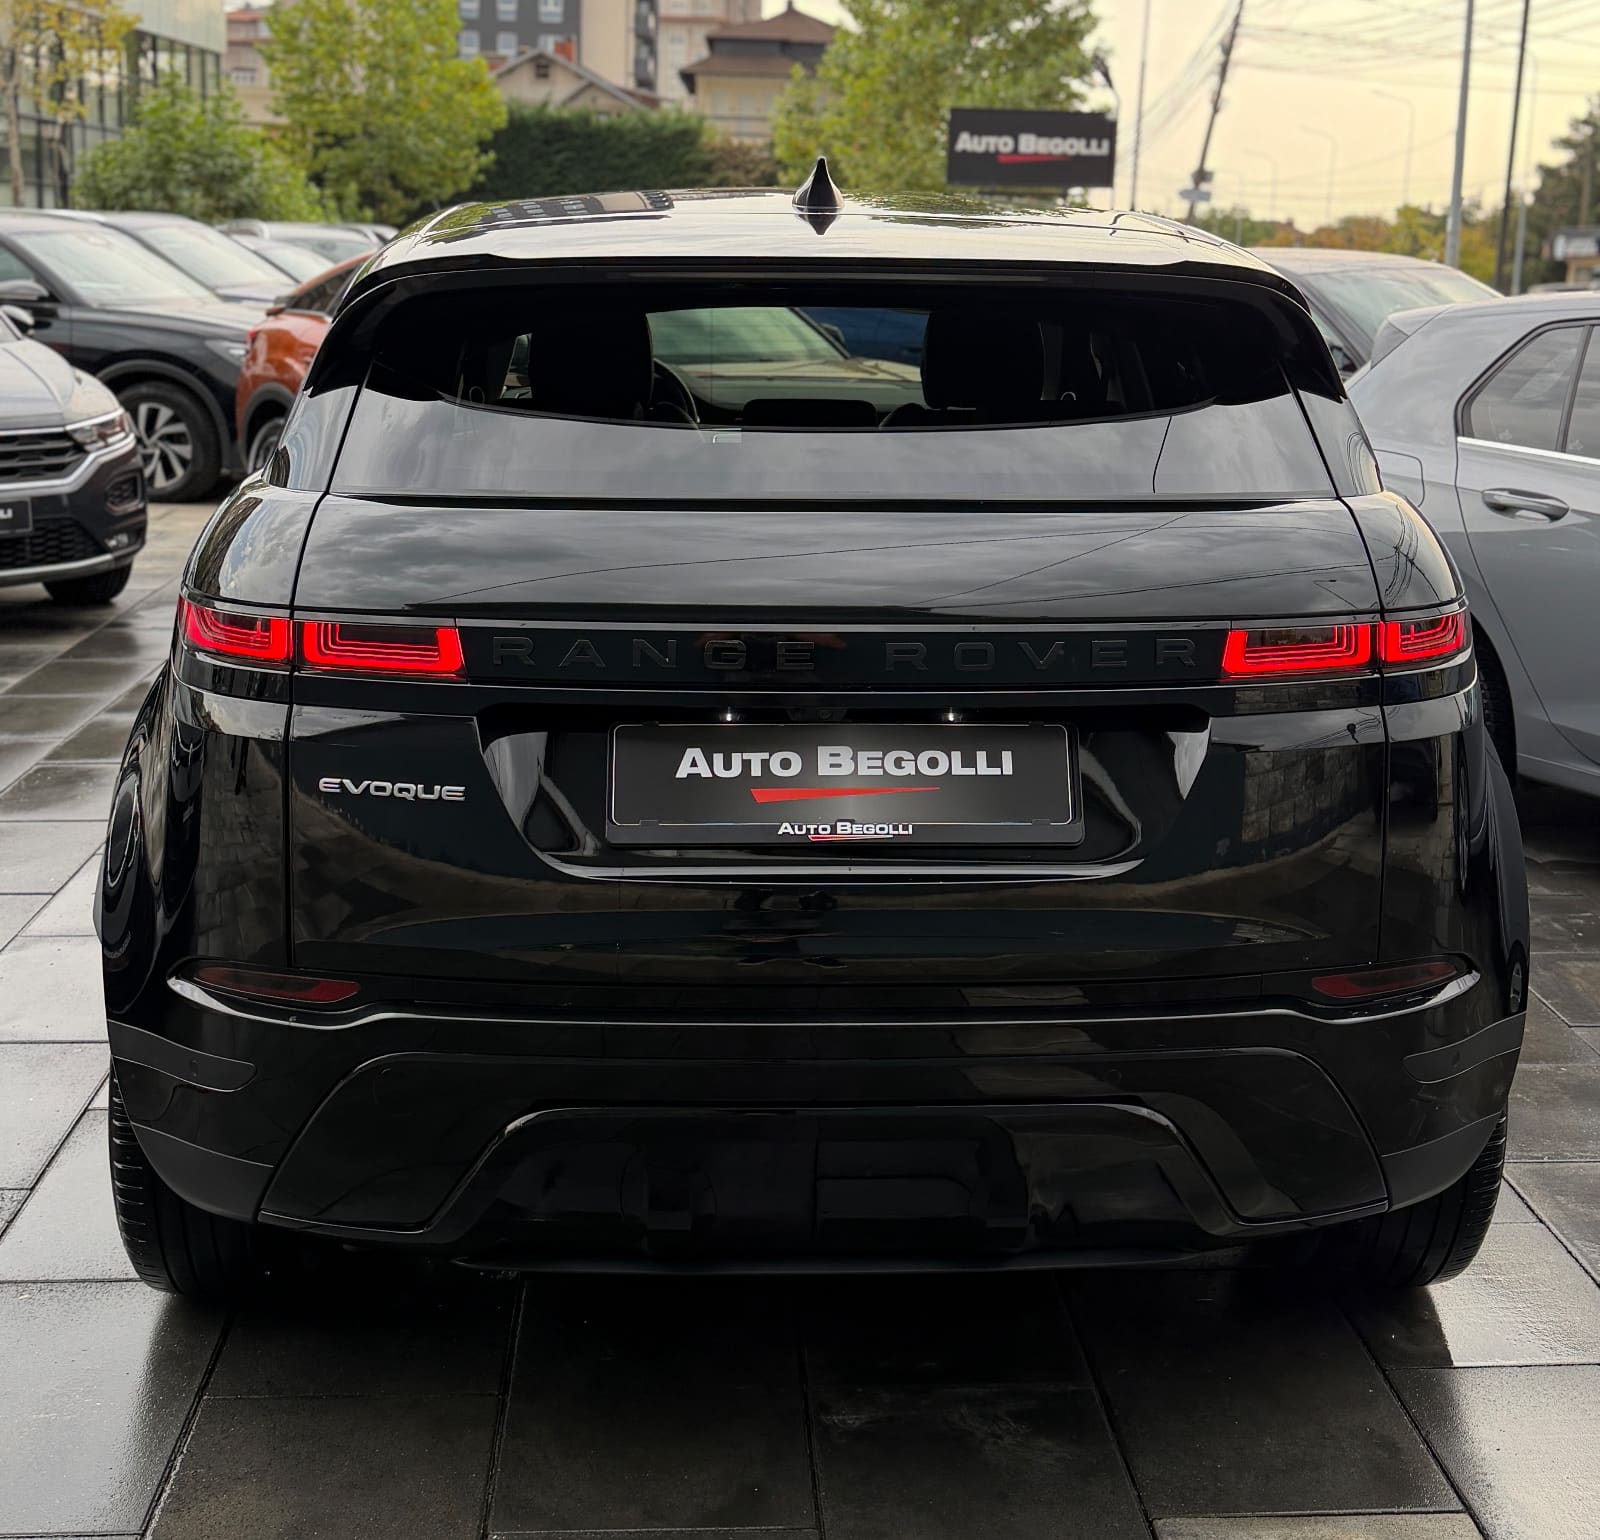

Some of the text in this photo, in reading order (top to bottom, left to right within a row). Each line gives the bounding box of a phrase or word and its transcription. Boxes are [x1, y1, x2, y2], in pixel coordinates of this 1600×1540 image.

[955, 131, 1110, 156] AUTO BEGOLLI
[491, 635, 1197, 671] RANGE ROVER
[675, 745, 1013, 778] AUTO BEGOLLI
[318, 777, 466, 801] EVOQUE
[777, 821, 913, 835] AUTO BEGOLLI
